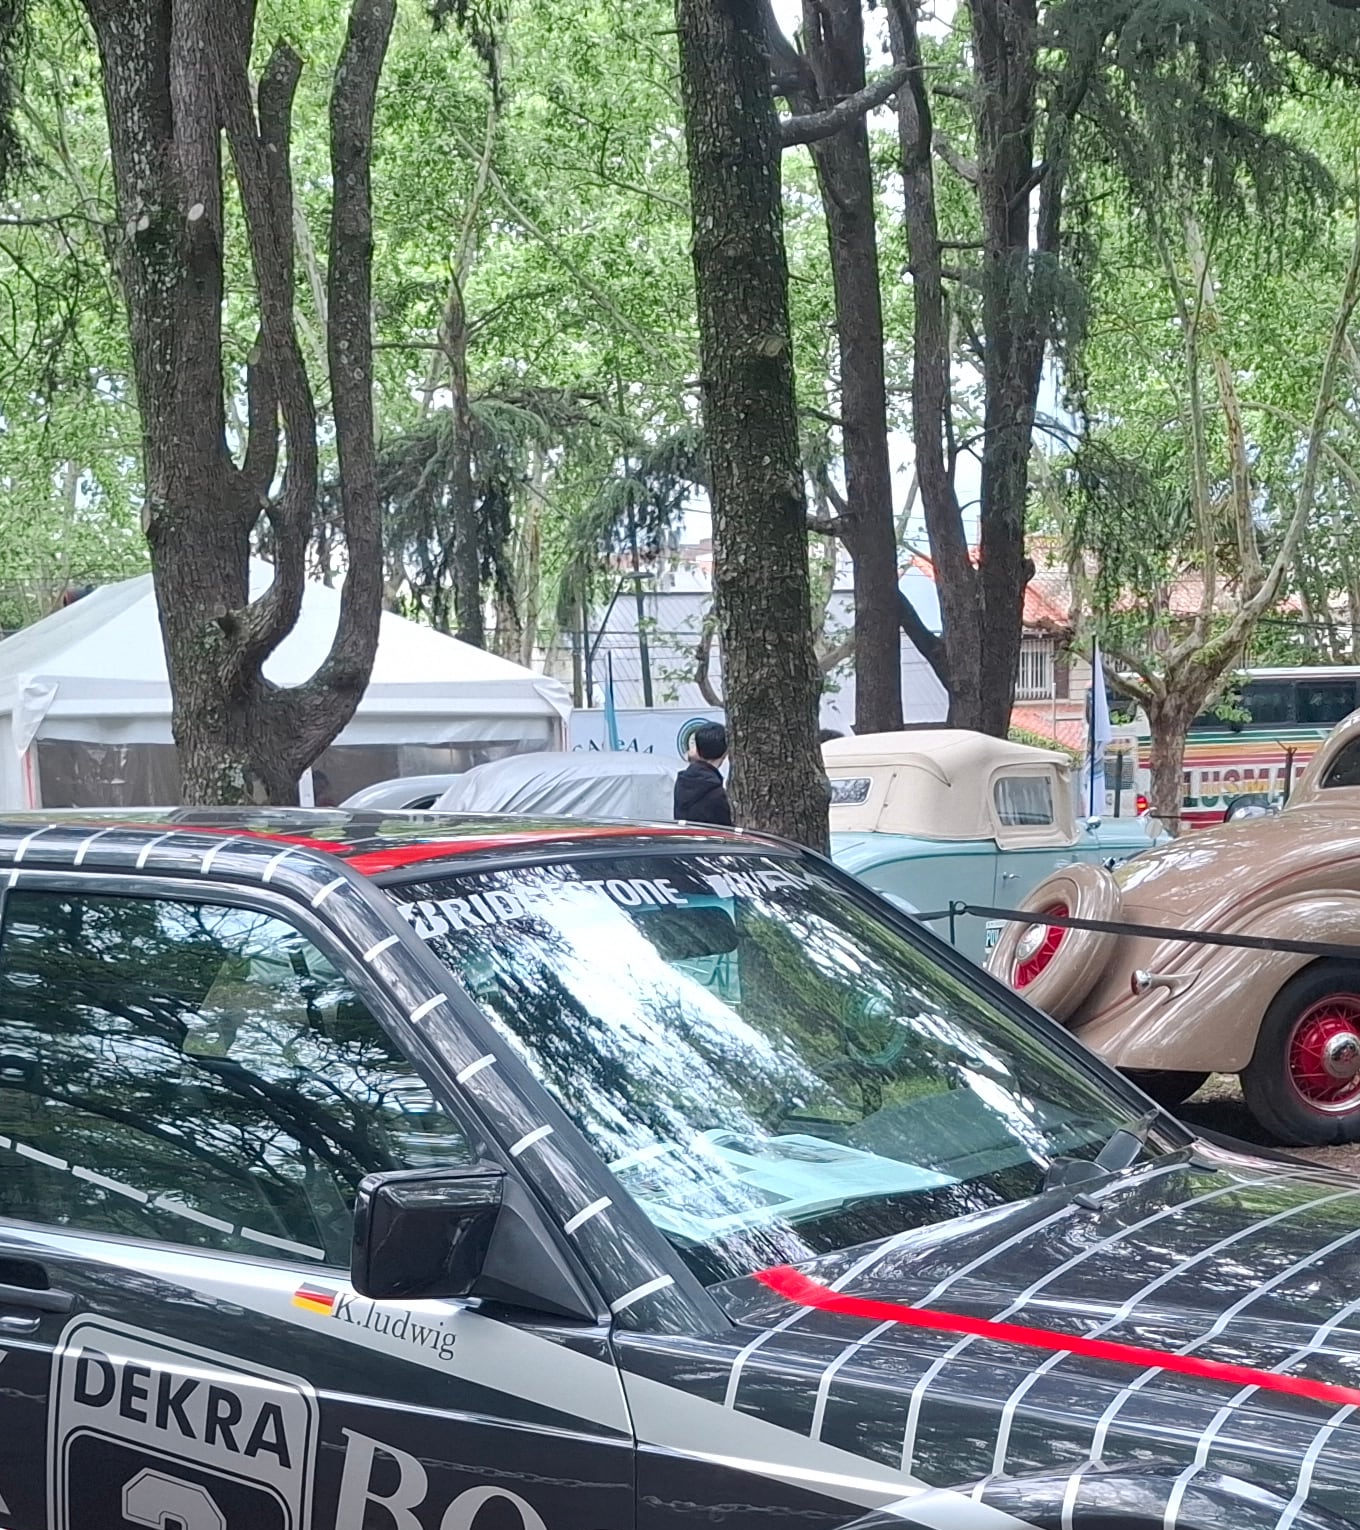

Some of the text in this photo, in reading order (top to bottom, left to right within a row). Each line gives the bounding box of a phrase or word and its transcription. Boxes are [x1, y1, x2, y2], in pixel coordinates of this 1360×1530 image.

[1182, 766, 1305, 808] LUSM
[397, 878, 688, 939] BRIDTONE
[331, 1293, 456, 1361] K.ludwig
[73, 1349, 293, 1469] DEKRA
